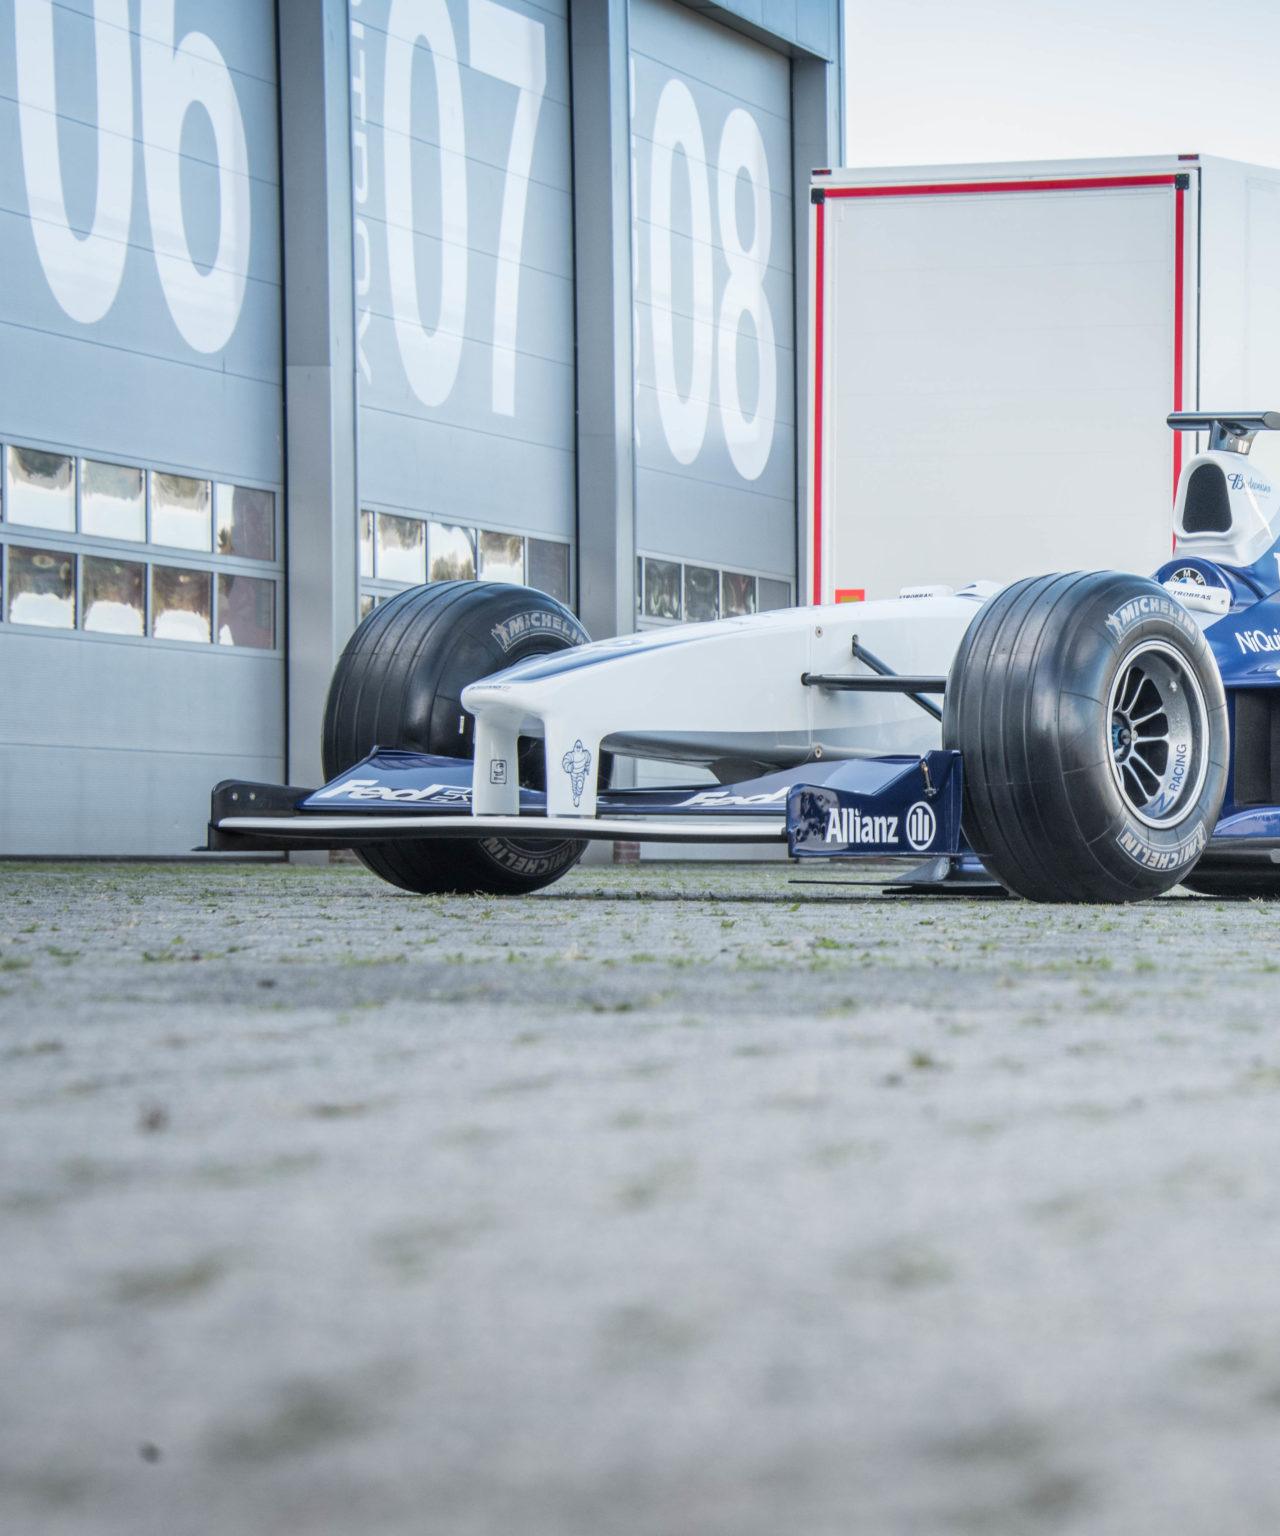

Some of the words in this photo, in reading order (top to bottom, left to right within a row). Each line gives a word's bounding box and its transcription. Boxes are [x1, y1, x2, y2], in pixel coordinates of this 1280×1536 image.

[14, 0, 251, 355] 06
[383, 0, 547, 418] 07
[649, 78, 777, 481] 08
[1119, 597, 1196, 635] MICHELIN
[1170, 743, 1187, 793] RACING
[825, 807, 899, 843] Allianz
[481, 837, 570, 874] MICHELIN
[1119, 831, 1201, 870] MICHELIN
